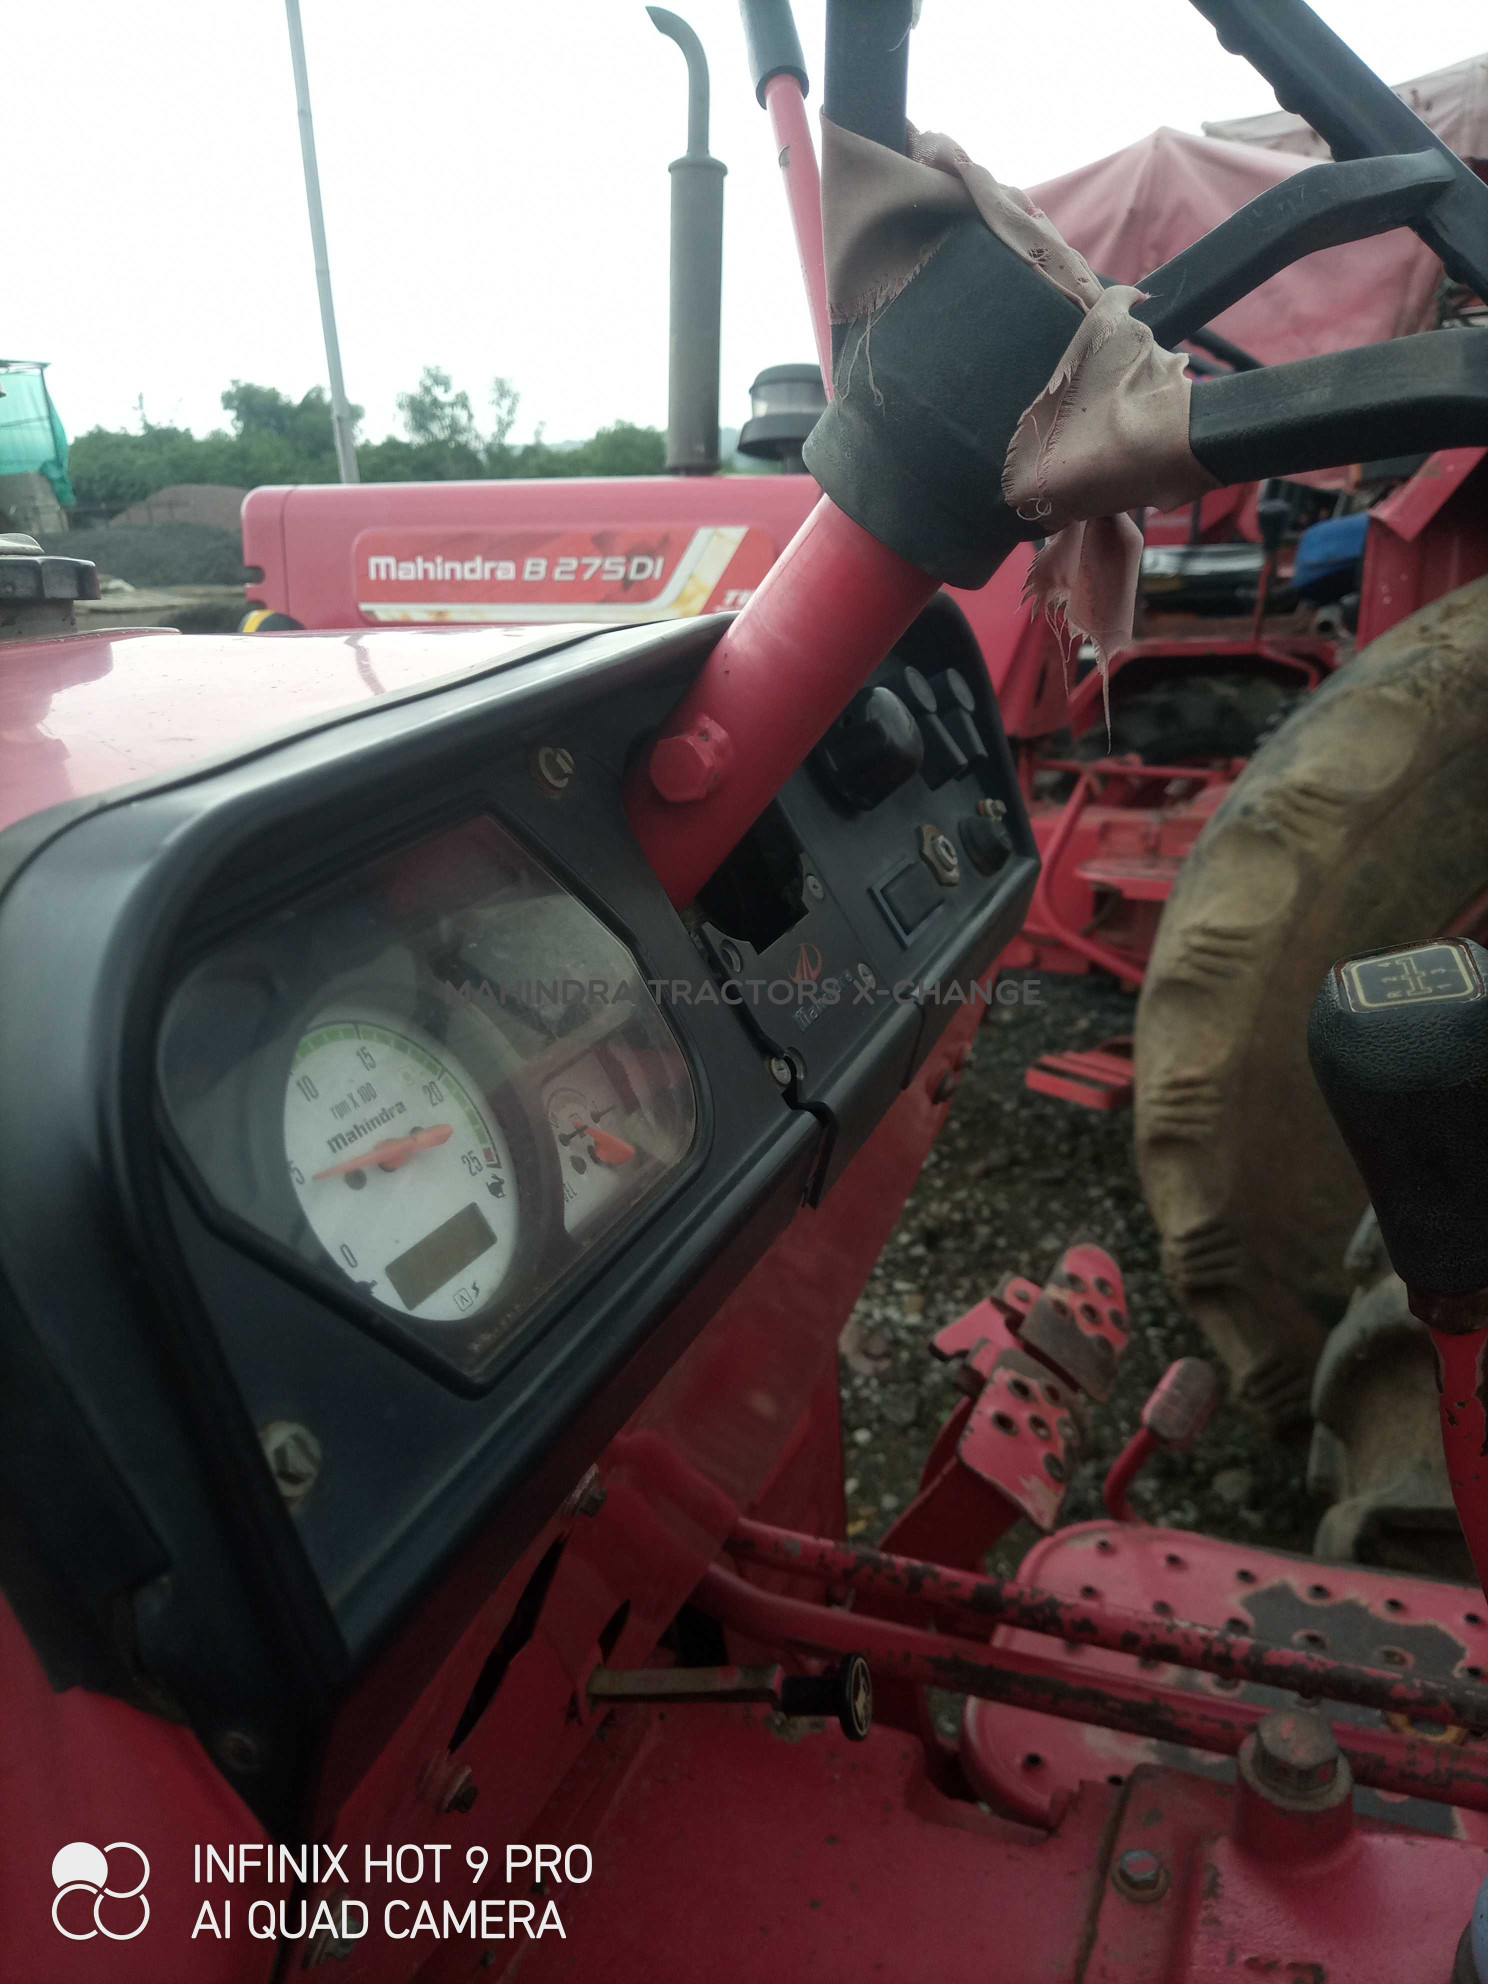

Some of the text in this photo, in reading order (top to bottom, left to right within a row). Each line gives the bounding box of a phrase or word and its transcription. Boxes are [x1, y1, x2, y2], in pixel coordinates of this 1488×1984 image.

[368, 555, 516, 581] Mahindra
[523, 556, 548, 581] B
[356, 1046, 376, 1071] 15
[296, 1075, 319, 1101] 10
[422, 1082, 444, 1106] 20
[327, 1101, 407, 1153] Mahindra
[461, 1151, 483, 1176] 25
[340, 1244, 358, 1268] 0
